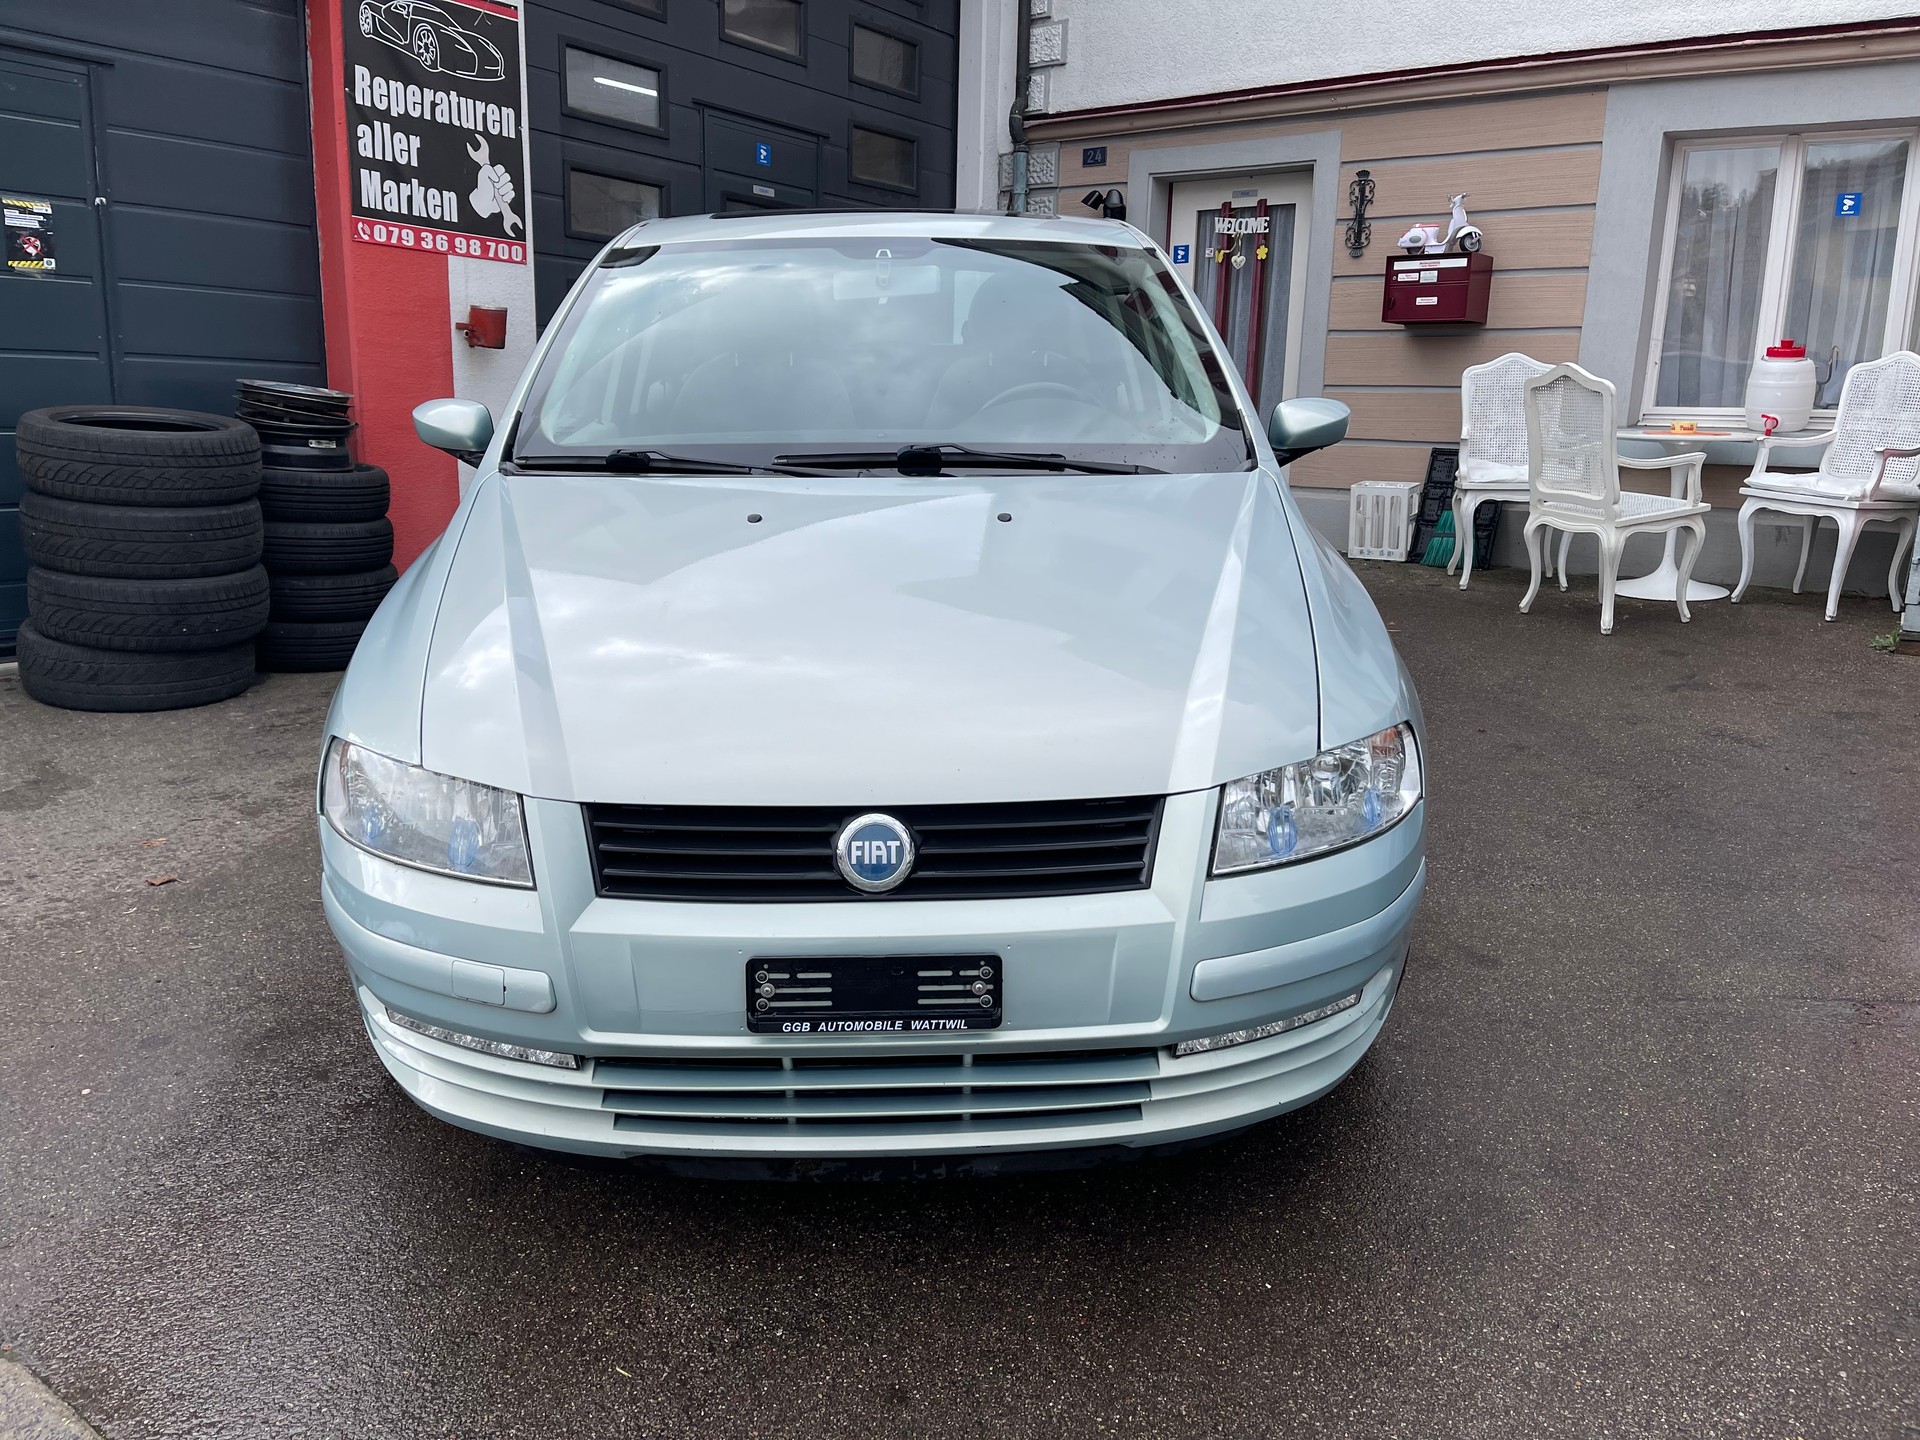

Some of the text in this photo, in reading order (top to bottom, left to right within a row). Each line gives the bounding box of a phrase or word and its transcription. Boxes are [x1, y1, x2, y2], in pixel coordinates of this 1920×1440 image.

[355, 64, 516, 139] Reperaturen
[356, 120, 421, 167] aller
[1087, 150, 1102, 163] 24
[360, 169, 459, 223] Marken
[1214, 216, 1270, 234] WELCOME
[373, 224, 523, 262] 079 36 98 700
[851, 841, 900, 865] FIAT
[782, 1019, 968, 1032] GGB AUTOMOBILE WATTWIL
